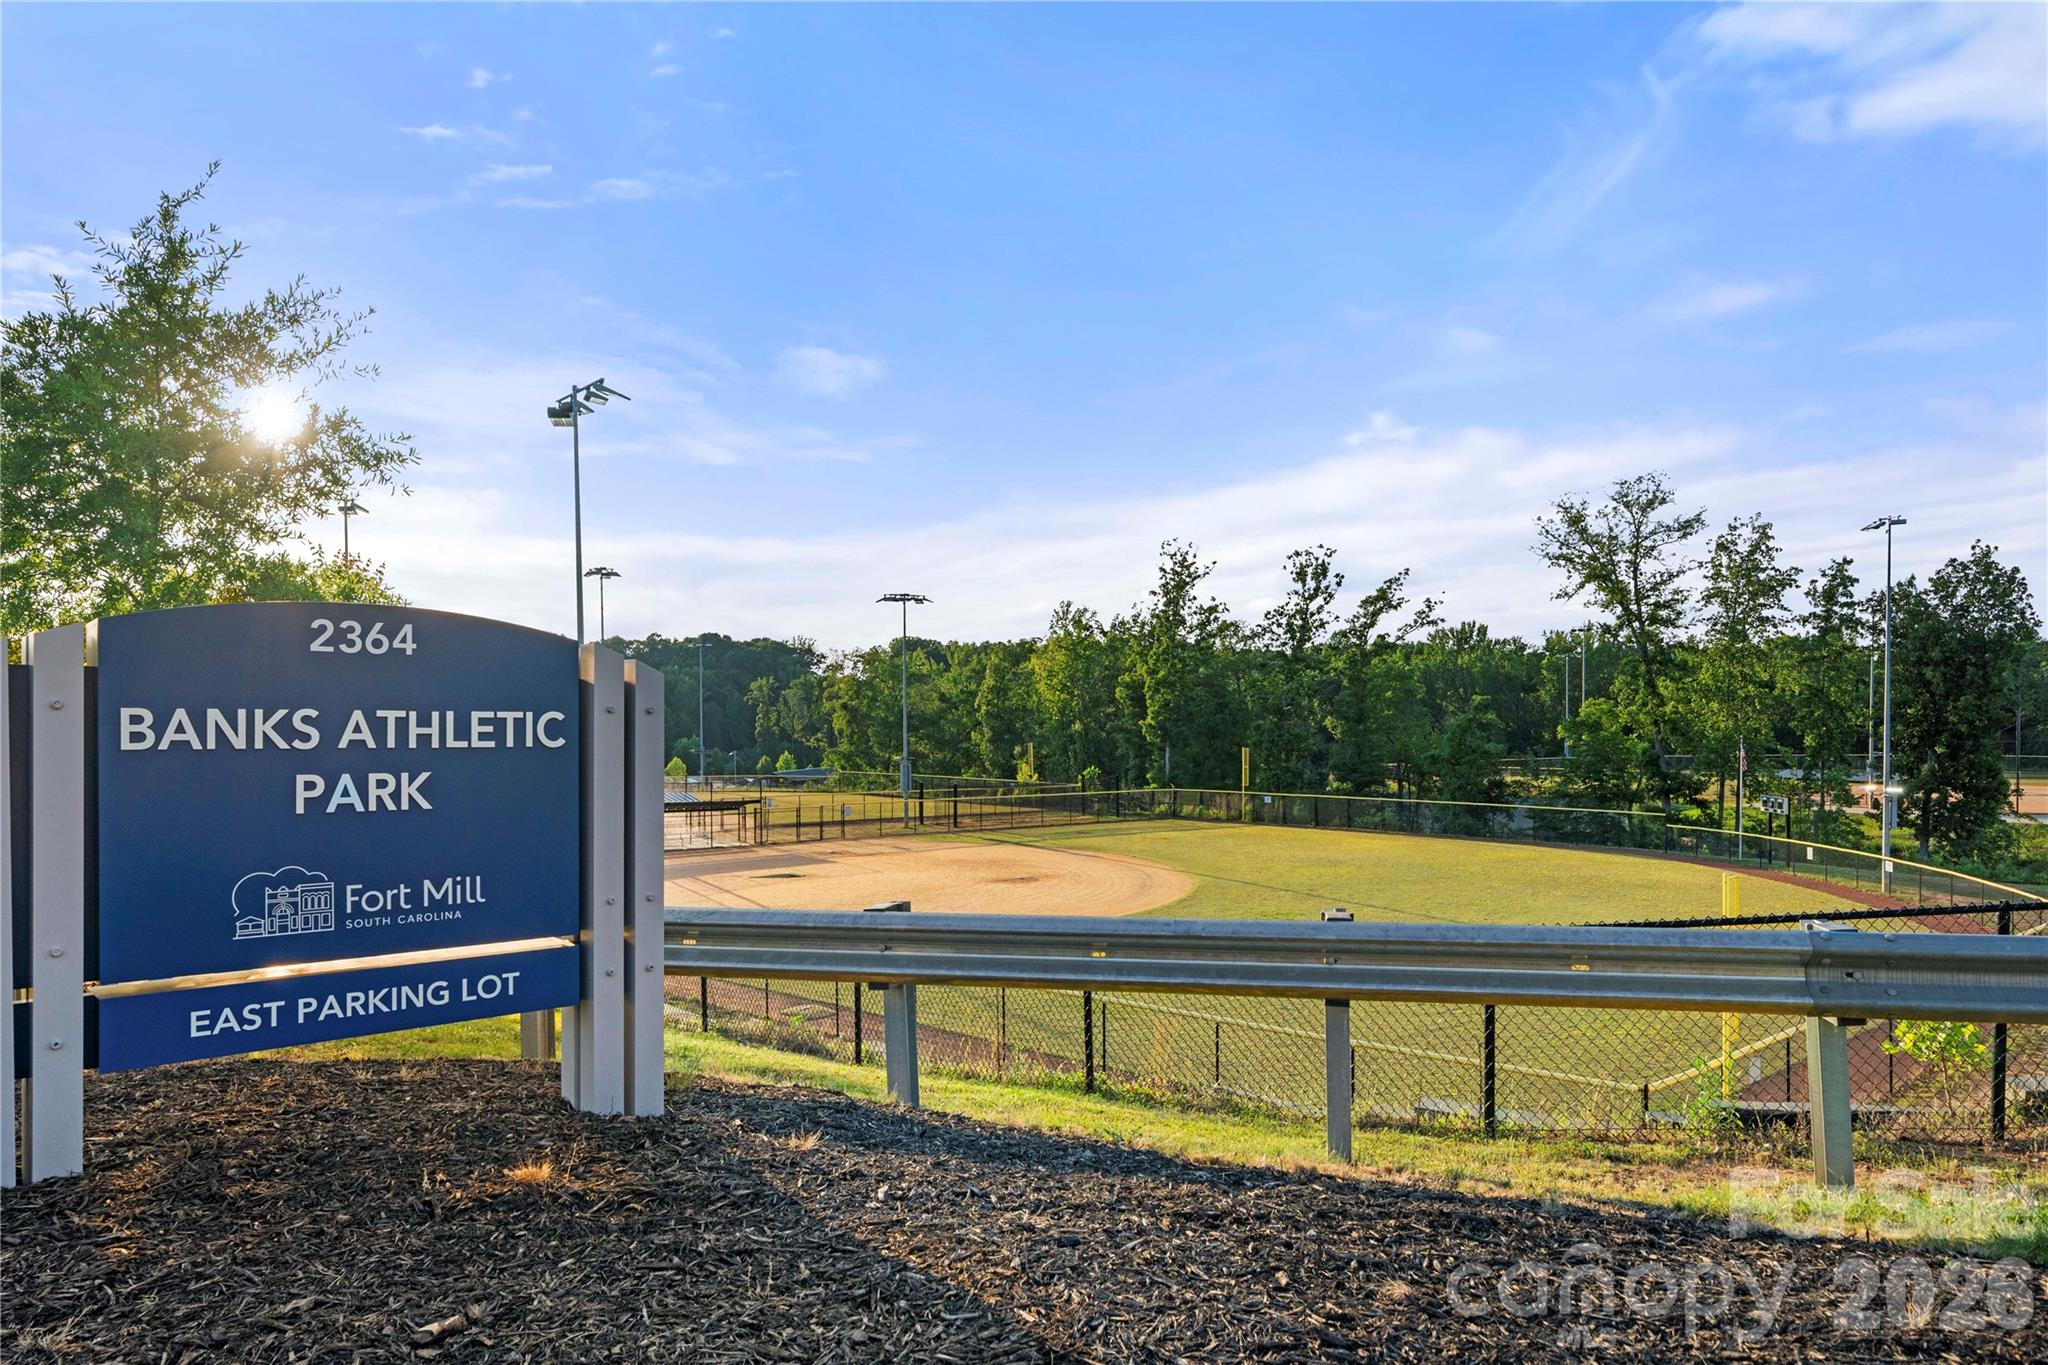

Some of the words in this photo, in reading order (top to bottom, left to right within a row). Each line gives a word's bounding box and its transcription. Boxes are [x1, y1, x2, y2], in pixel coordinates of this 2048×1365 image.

[309, 618, 417, 655] 2364
[119, 707, 321, 751] BANKS
[337, 709, 567, 749] ATHLETIC
[295, 771, 433, 814] PARK
[346, 883, 412, 914] Fort
[423, 875, 486, 907] Mill
[346, 916, 391, 928] SOUTH
[397, 910, 462, 924] CAROLINA
[190, 1001, 285, 1038] EAST
[298, 981, 449, 1023] PARKING
[462, 973, 519, 1002] LOT
